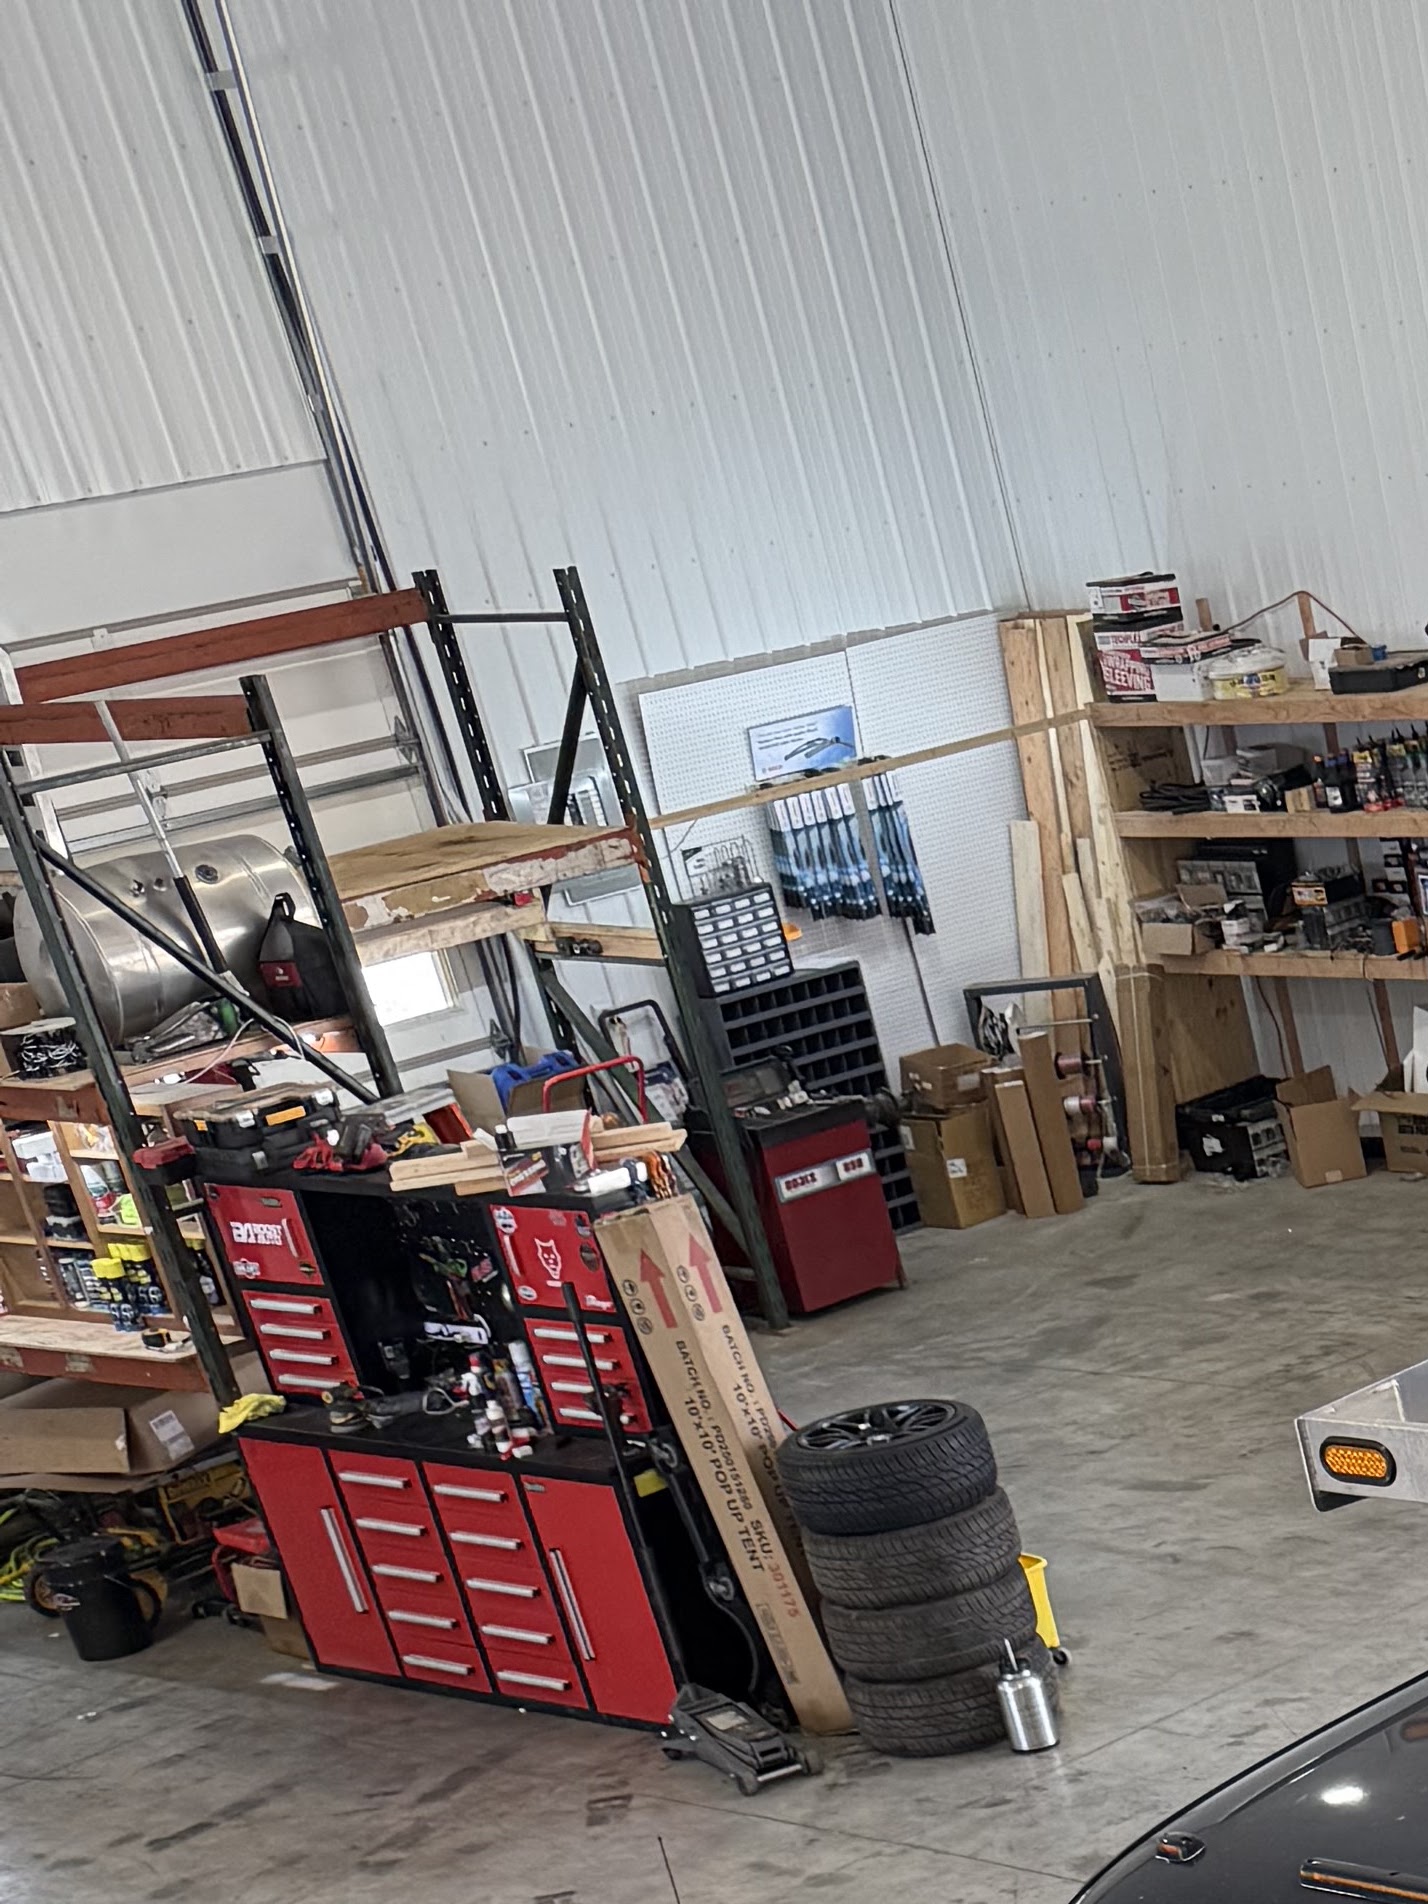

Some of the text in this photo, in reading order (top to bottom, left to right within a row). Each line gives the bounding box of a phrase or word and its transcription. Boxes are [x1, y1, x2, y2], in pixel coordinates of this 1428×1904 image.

[709, 1457, 734, 1500] POP
[724, 1499, 746, 1530] UP
[737, 1523, 765, 1574] TENT
